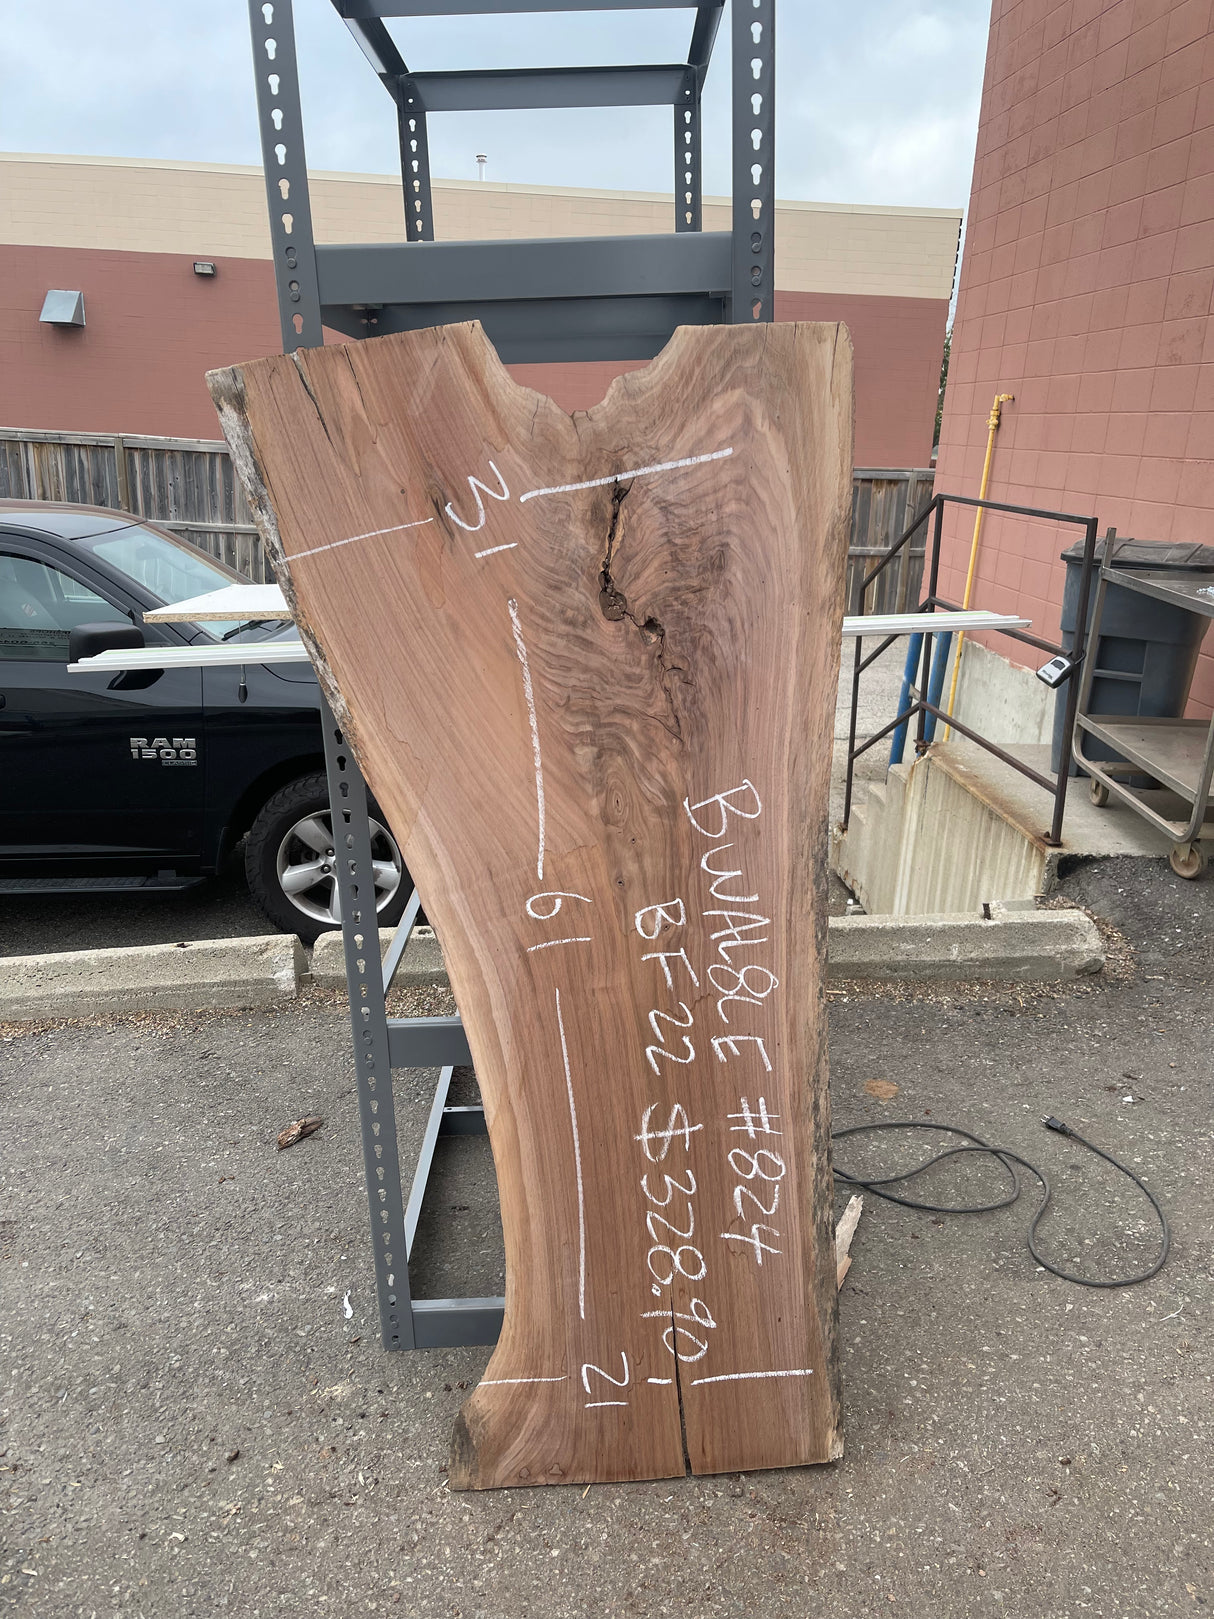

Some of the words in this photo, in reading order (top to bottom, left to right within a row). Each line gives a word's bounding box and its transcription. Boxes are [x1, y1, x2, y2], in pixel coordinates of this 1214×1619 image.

[130, 737, 196, 748] RAM
[130, 748, 197, 759] 1500
[719, 1096, 787, 1266] #824
[633, 1102, 718, 1363] $328.90
